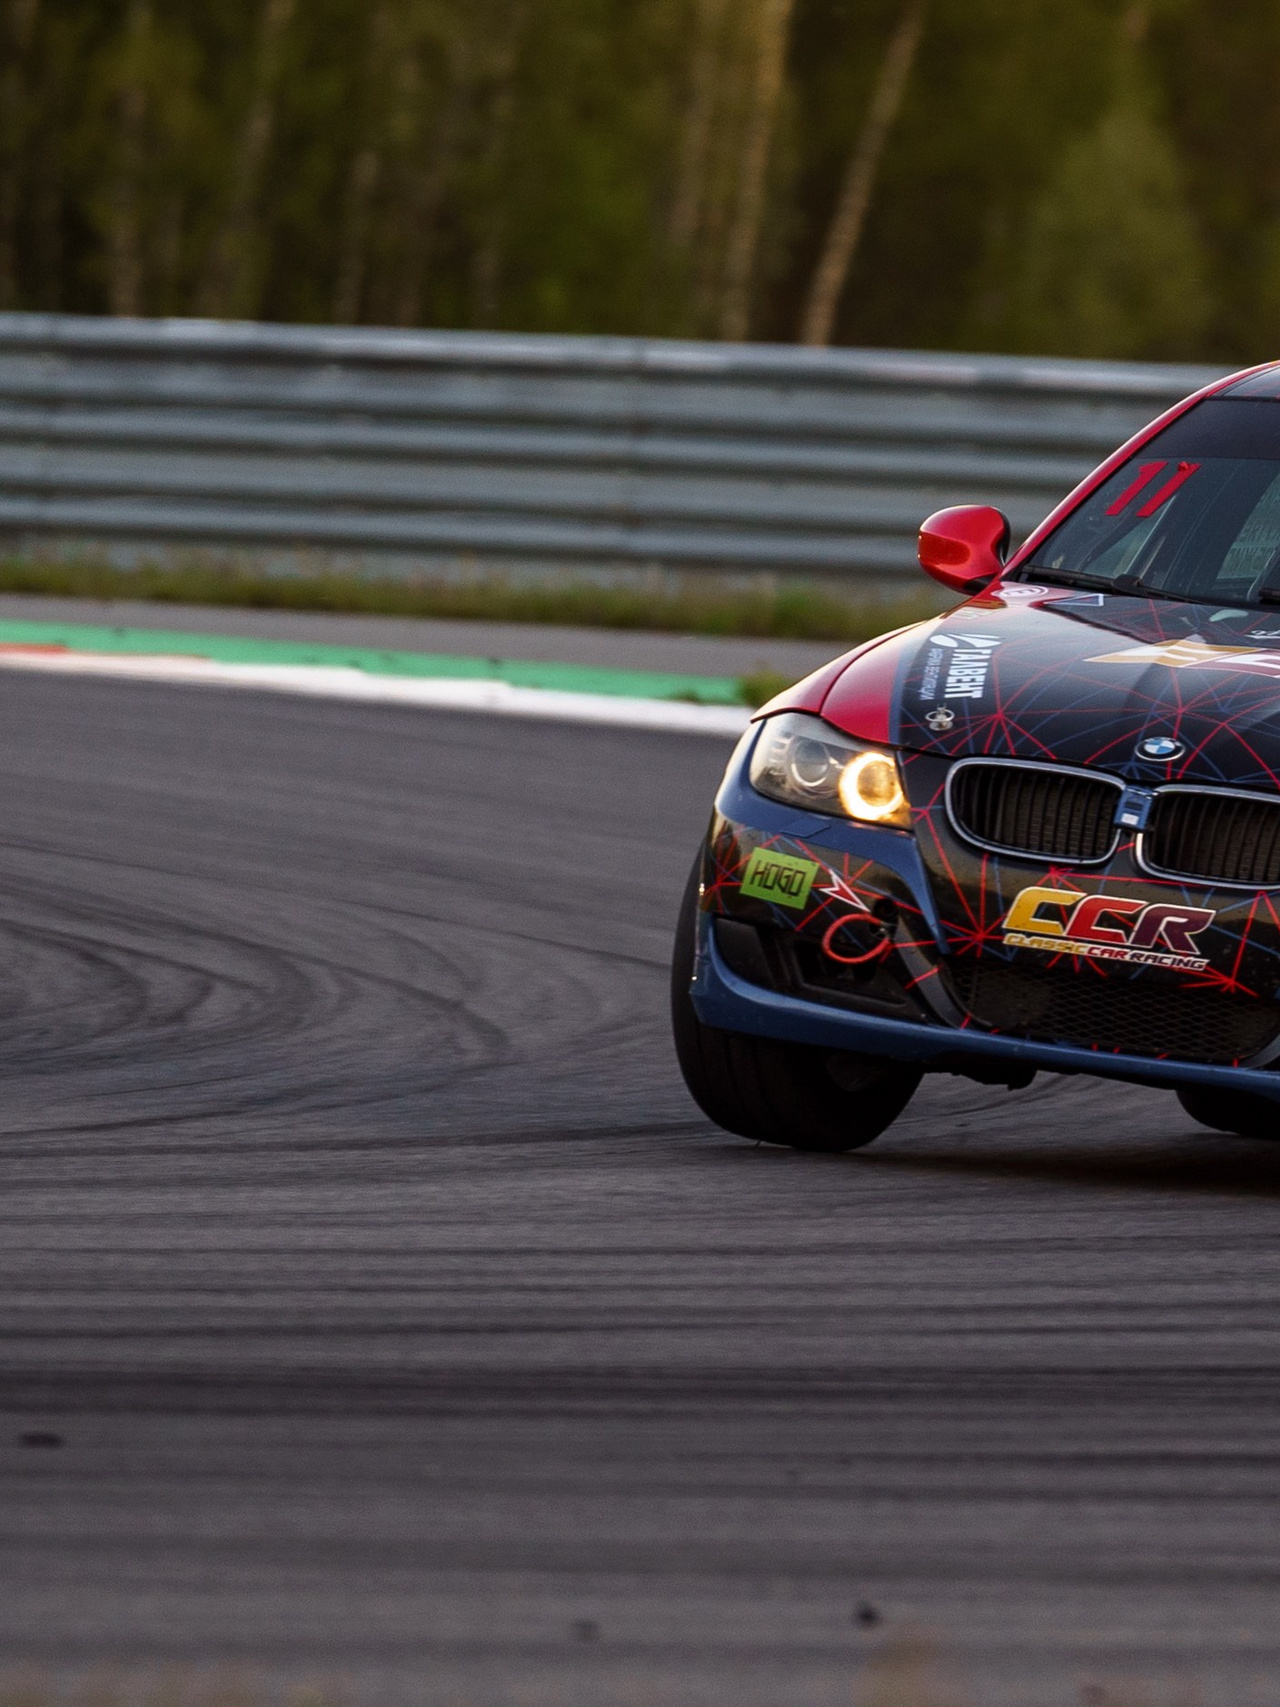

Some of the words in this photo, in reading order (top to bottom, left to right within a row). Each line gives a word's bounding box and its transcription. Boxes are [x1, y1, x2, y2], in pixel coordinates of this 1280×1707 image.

[1104, 460, 1201, 517] 11
[749, 860, 807, 897] HOGO
[1003, 886, 1216, 954] CCR
[1003, 933, 1088, 953] CLASSIC
[1087, 946, 1130, 960] CAR
[1129, 952, 1211, 971] RACING
